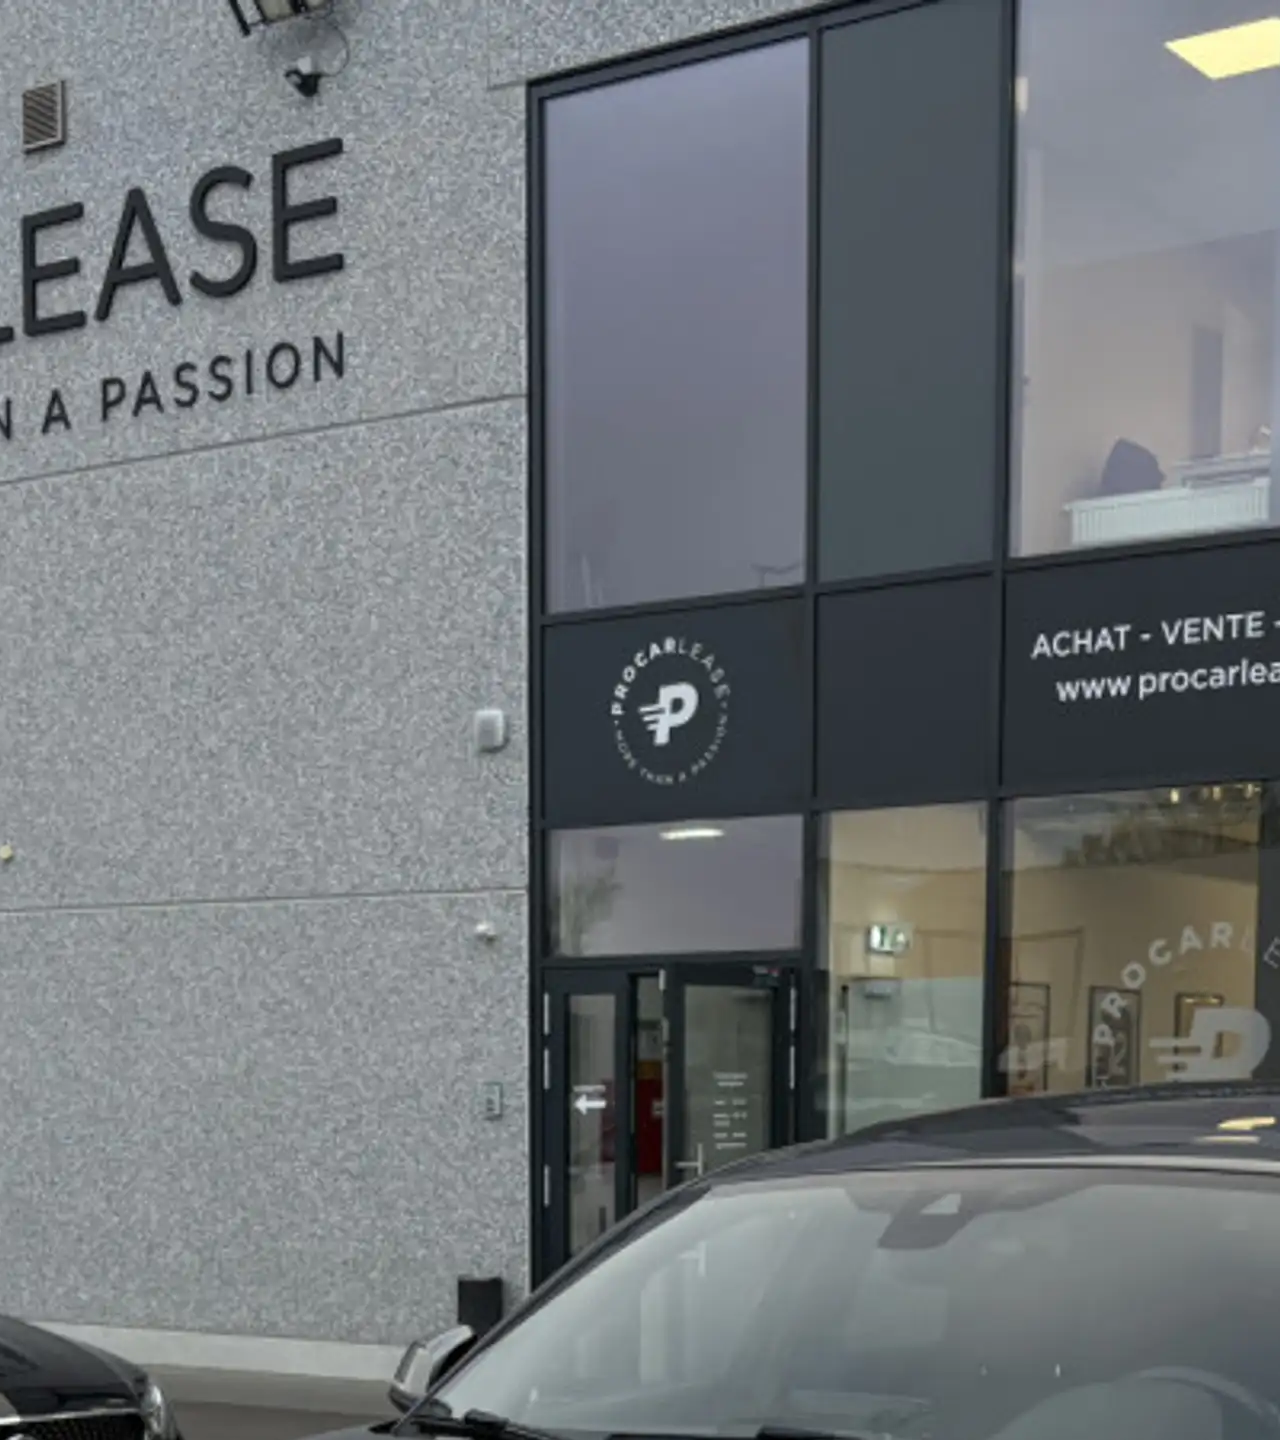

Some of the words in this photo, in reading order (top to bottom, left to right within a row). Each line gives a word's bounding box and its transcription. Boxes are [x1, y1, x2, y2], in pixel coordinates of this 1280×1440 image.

[41, 389, 72, 434] A
[100, 331, 347, 423] PASSION
[1030, 624, 1131, 659] ACHAT
[1160, 610, 1266, 645] VENTE
